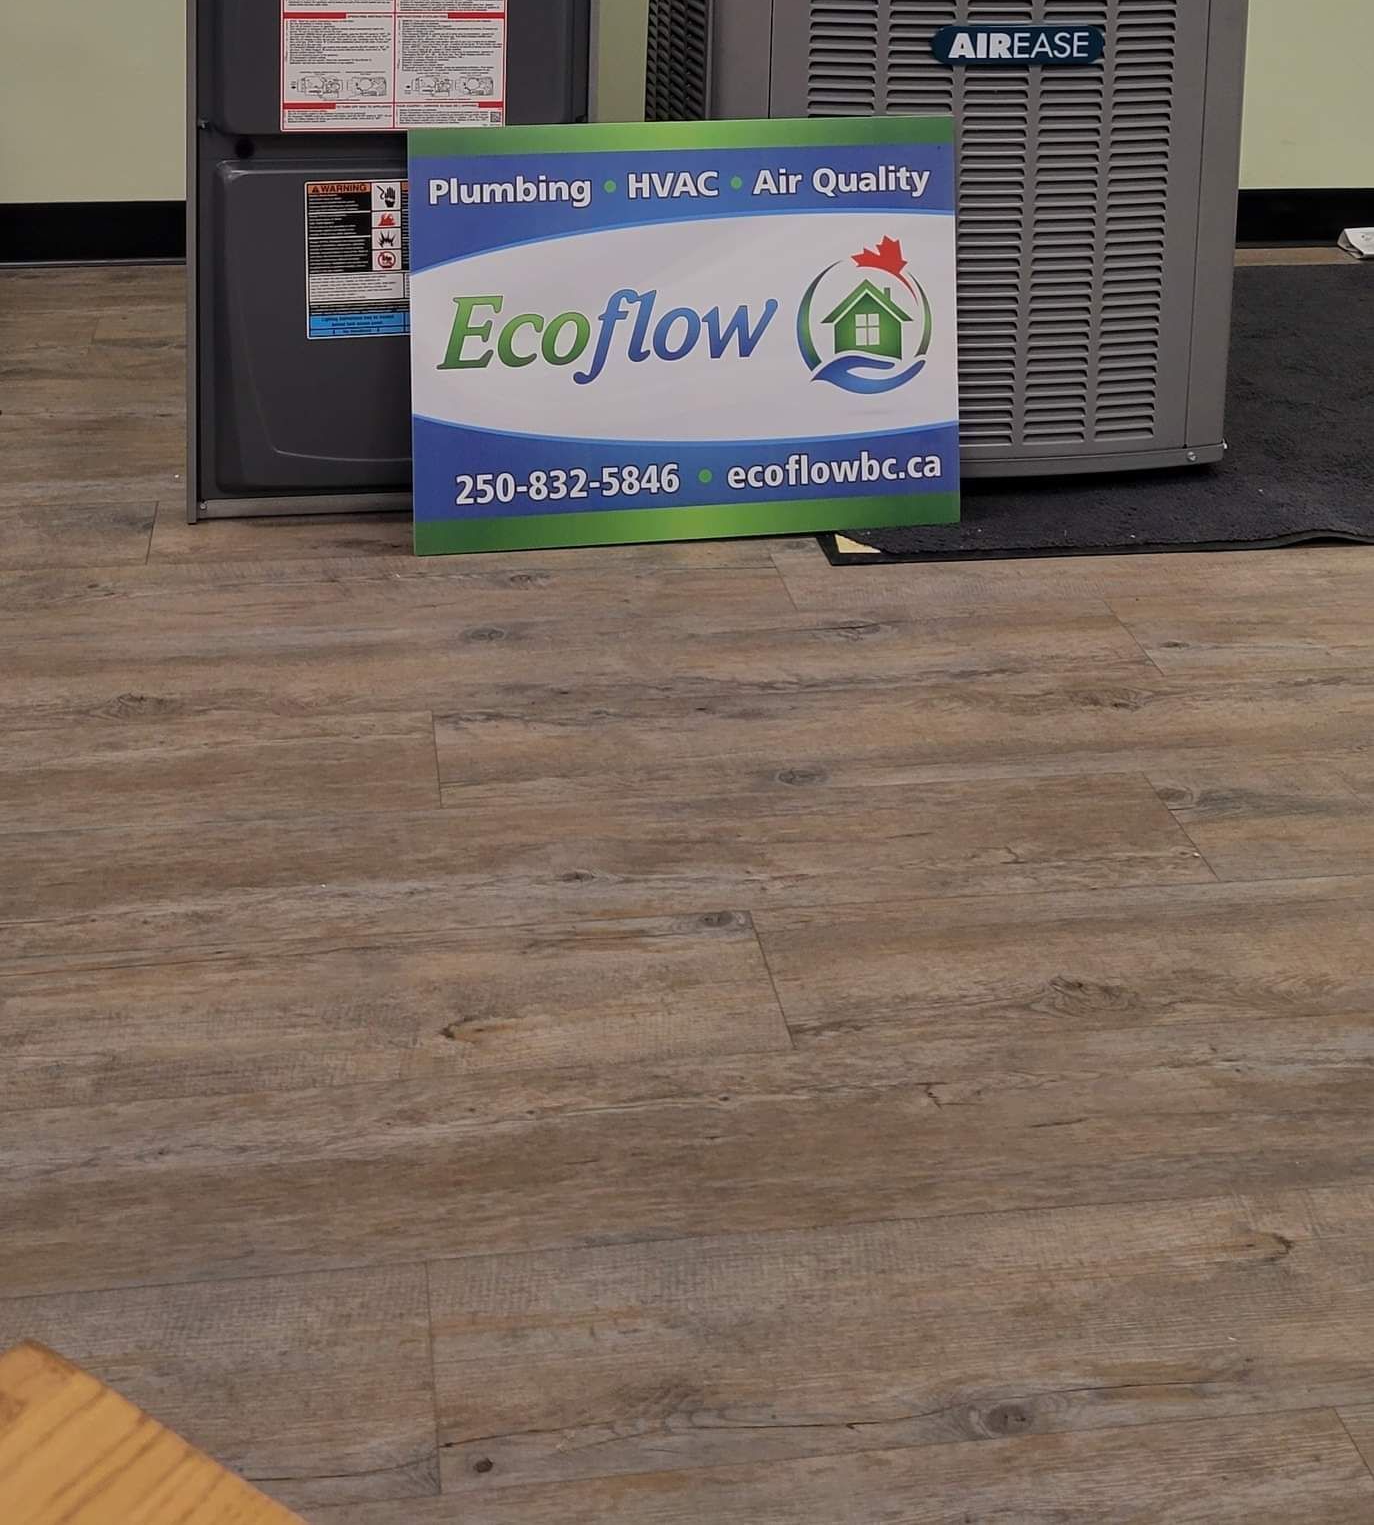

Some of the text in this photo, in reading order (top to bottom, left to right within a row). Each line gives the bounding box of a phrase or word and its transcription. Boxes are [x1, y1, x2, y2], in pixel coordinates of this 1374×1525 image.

[948, 30, 1090, 60] AIREASE
[321, 183, 367, 193] WARNING
[427, 165, 930, 207] Plumbing HVAC Air Quality
[436, 288, 778, 386] Ecoflow
[455, 451, 942, 506] 250-832-5846 ecoflowbc.ca
